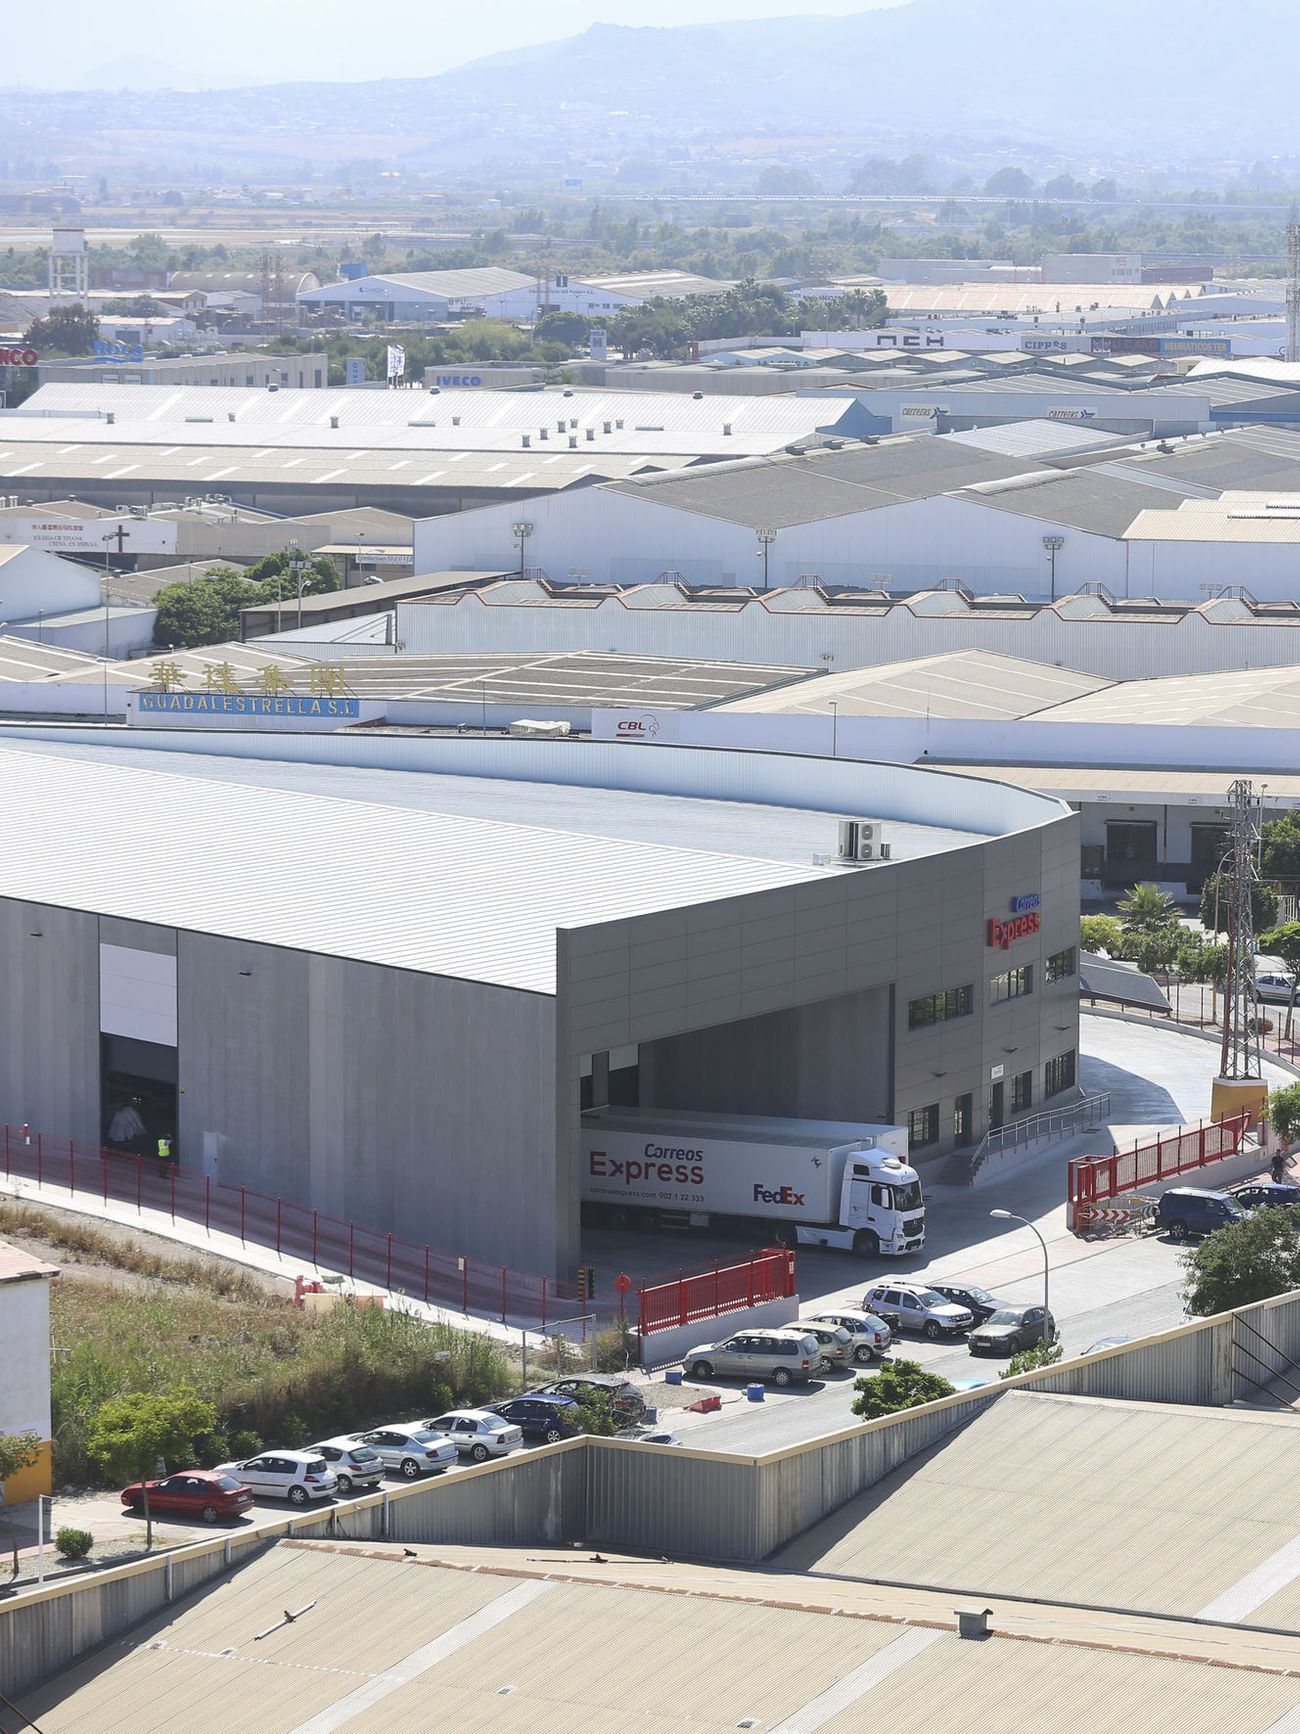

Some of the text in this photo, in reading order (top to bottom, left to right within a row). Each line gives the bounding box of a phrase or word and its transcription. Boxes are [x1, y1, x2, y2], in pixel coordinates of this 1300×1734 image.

[436, 376, 481, 386] IVECO
[902, 407, 932, 416] carreras
[143, 695, 321, 714] GUADALESTRELLA
[617, 721, 646, 730] CBL
[1013, 892, 1041, 912] Correos
[989, 912, 1041, 949] Express
[644, 1143, 704, 1162] Correos
[589, 1151, 704, 1185] Express
[753, 1183, 806, 1206] FedEx
